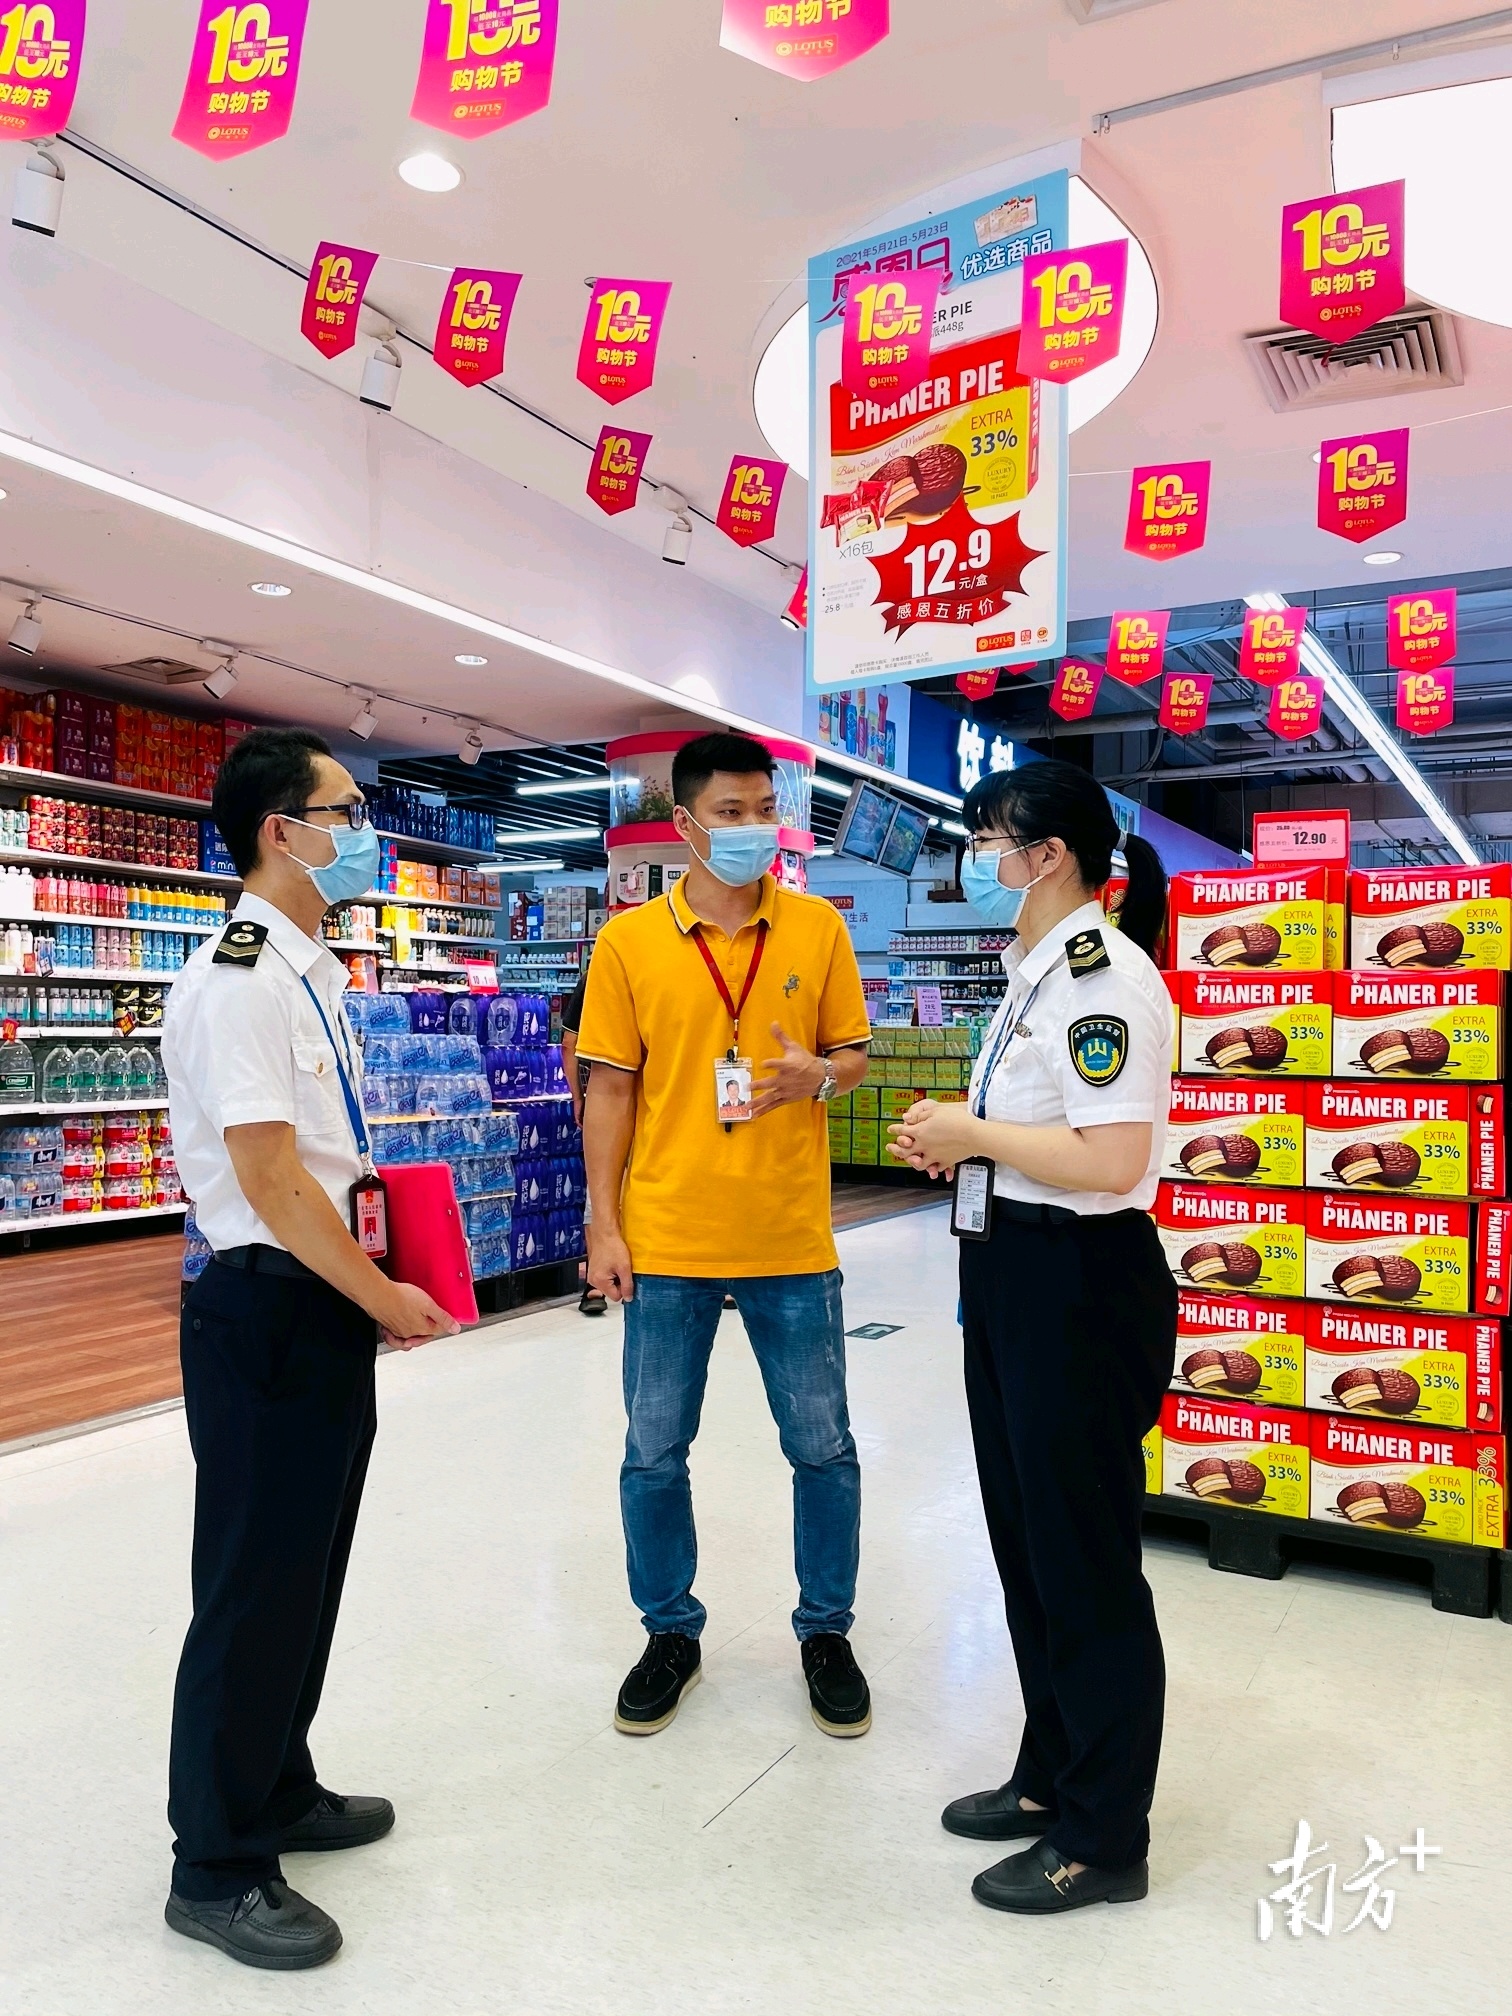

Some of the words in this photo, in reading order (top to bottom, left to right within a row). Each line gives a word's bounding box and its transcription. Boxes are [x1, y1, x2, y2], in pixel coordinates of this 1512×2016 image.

[0, 3, 70, 78] 10元
[207, 3, 289, 83] 10元
[450, 61, 524, 92] 购物节
[208, 90, 271, 114] 购物节
[1292, 203, 1391, 271] 10元
[960, 229, 1053, 280] 优选商品
[316, 254, 359, 305] 10元
[1311, 269, 1376, 297] 购物节
[450, 279, 502, 331] 10元
[1032, 261, 1112, 328] 10元
[315, 307, 346, 326] 购物节
[595, 289, 652, 343] 10元
[855, 282, 922, 342] 10元
[951, 301, 973, 319] PIE
[451, 334, 489, 353] 购物节
[1043, 327, 1100, 351] 购物节
[595, 348, 638, 366] 购物节
[862, 345, 910, 366] 购物节
[960, 360, 1004, 402] PIE
[971, 408, 1013, 430] EXTRA
[970, 427, 1018, 457] 33%
[600, 436, 638, 475] 10元
[987, 467, 1012, 477] LUXURY
[1327, 444, 1396, 493] 10元
[599, 476, 628, 491] 购物节
[730, 464, 772, 506] 10元
[1138, 474, 1198, 520] 10元
[1338, 494, 1386, 512] 购物节
[730, 507, 762, 522] 购物节
[1145, 523, 1188, 537] 购物节
[903, 528, 991, 598] 12.9
[958, 573, 988, 590] 元/盒
[896, 598, 994, 620] 感恩五折价
[1393, 600, 1448, 638] 10元
[989, 635, 1014, 644] LOTUS
[1116, 617, 1158, 650] 10元
[1249, 615, 1295, 649] 10元
[1404, 637, 1440, 651] 购物节
[1120, 653, 1150, 664] 购物节
[1253, 652, 1287, 663] 购物节
[1062, 665, 1094, 694] 10元
[1402, 675, 1447, 705] 10元
[1062, 694, 1085, 705] 购物节
[1169, 679, 1204, 706] 10元
[1277, 681, 1316, 710] 10元
[1171, 708, 1197, 717] 购物节
[1281, 712, 1309, 721] 购物节
[1409, 706, 1440, 716] 购物节
[1293, 831, 1326, 845] 12.90
[1193, 882, 1270, 903] PHANER
[1275, 881, 1307, 900] PIE
[1367, 880, 1451, 903] PHANER
[1457, 878, 1491, 899] PIE
[1284, 910, 1313, 920] EXTRA
[1466, 908, 1498, 918] EXTRA
[1284, 923, 1317, 936] 33%
[1466, 921, 1502, 935] 33%
[1197, 984, 1275, 1004] PHANER
[1281, 984, 1314, 1004] PIE
[1351, 984, 1437, 1005] PHANER
[1443, 983, 1479, 1004] PIE
[1290, 1013, 1320, 1023] EXTRA
[1452, 1016, 1486, 1025] EXTRA
[1290, 1026, 1324, 1040] 33%
[1452, 1029, 1490, 1043] 33%
[1171, 1090, 1249, 1112] PHANER
[1254, 1093, 1287, 1113] PIE
[1322, 1095, 1407, 1119] PHANER
[1413, 1099, 1449, 1120] PIE
[1263, 1124, 1293, 1133] EXTRA
[1423, 1131, 1456, 1141] EXTRA
[1480, 1120, 1494, 1140] PIE
[1263, 1137, 1297, 1151] 33%
[1423, 1144, 1461, 1159] 33%
[1480, 1142, 1495, 1190] PHANER
[1172, 1196, 1250, 1221] PHANER
[1255, 1202, 1288, 1224] PIE
[1322, 1206, 1408, 1233] PHANER
[1414, 1213, 1449, 1236] PIE
[1264, 1232, 1294, 1243] EXTRA
[1487, 1208, 1503, 1257] PHANER
[1264, 1245, 1298, 1260] 33%
[1424, 1245, 1457, 1257] EXTRA
[1424, 1259, 1461, 1275] 33%
[1486, 1259, 1501, 1279] PIE
[1255, 1311, 1287, 1333] PIE
[1321, 1317, 1407, 1346] PHANER
[1413, 1327, 1448, 1350] PIE
[1264, 1342, 1294, 1354] EXTRA
[1475, 1325, 1490, 1374] PHANER
[1264, 1355, 1298, 1371] 33%
[1423, 1360, 1456, 1372] EXTRA
[1423, 1373, 1460, 1391] 33%
[1476, 1376, 1491, 1397] PIE
[1176, 1409, 1253, 1439] PHANER
[1259, 1421, 1292, 1445] PIE
[1327, 1429, 1412, 1461] PHANER
[1418, 1441, 1454, 1465] PIE
[1268, 1452, 1298, 1464] EXTRA
[1477, 1446, 1497, 1489] 33%
[1268, 1465, 1302, 1482] 33%
[1428, 1475, 1461, 1488] EXTRA
[1428, 1488, 1466, 1506] 33%
[1486, 1494, 1499, 1538] EXTRA
